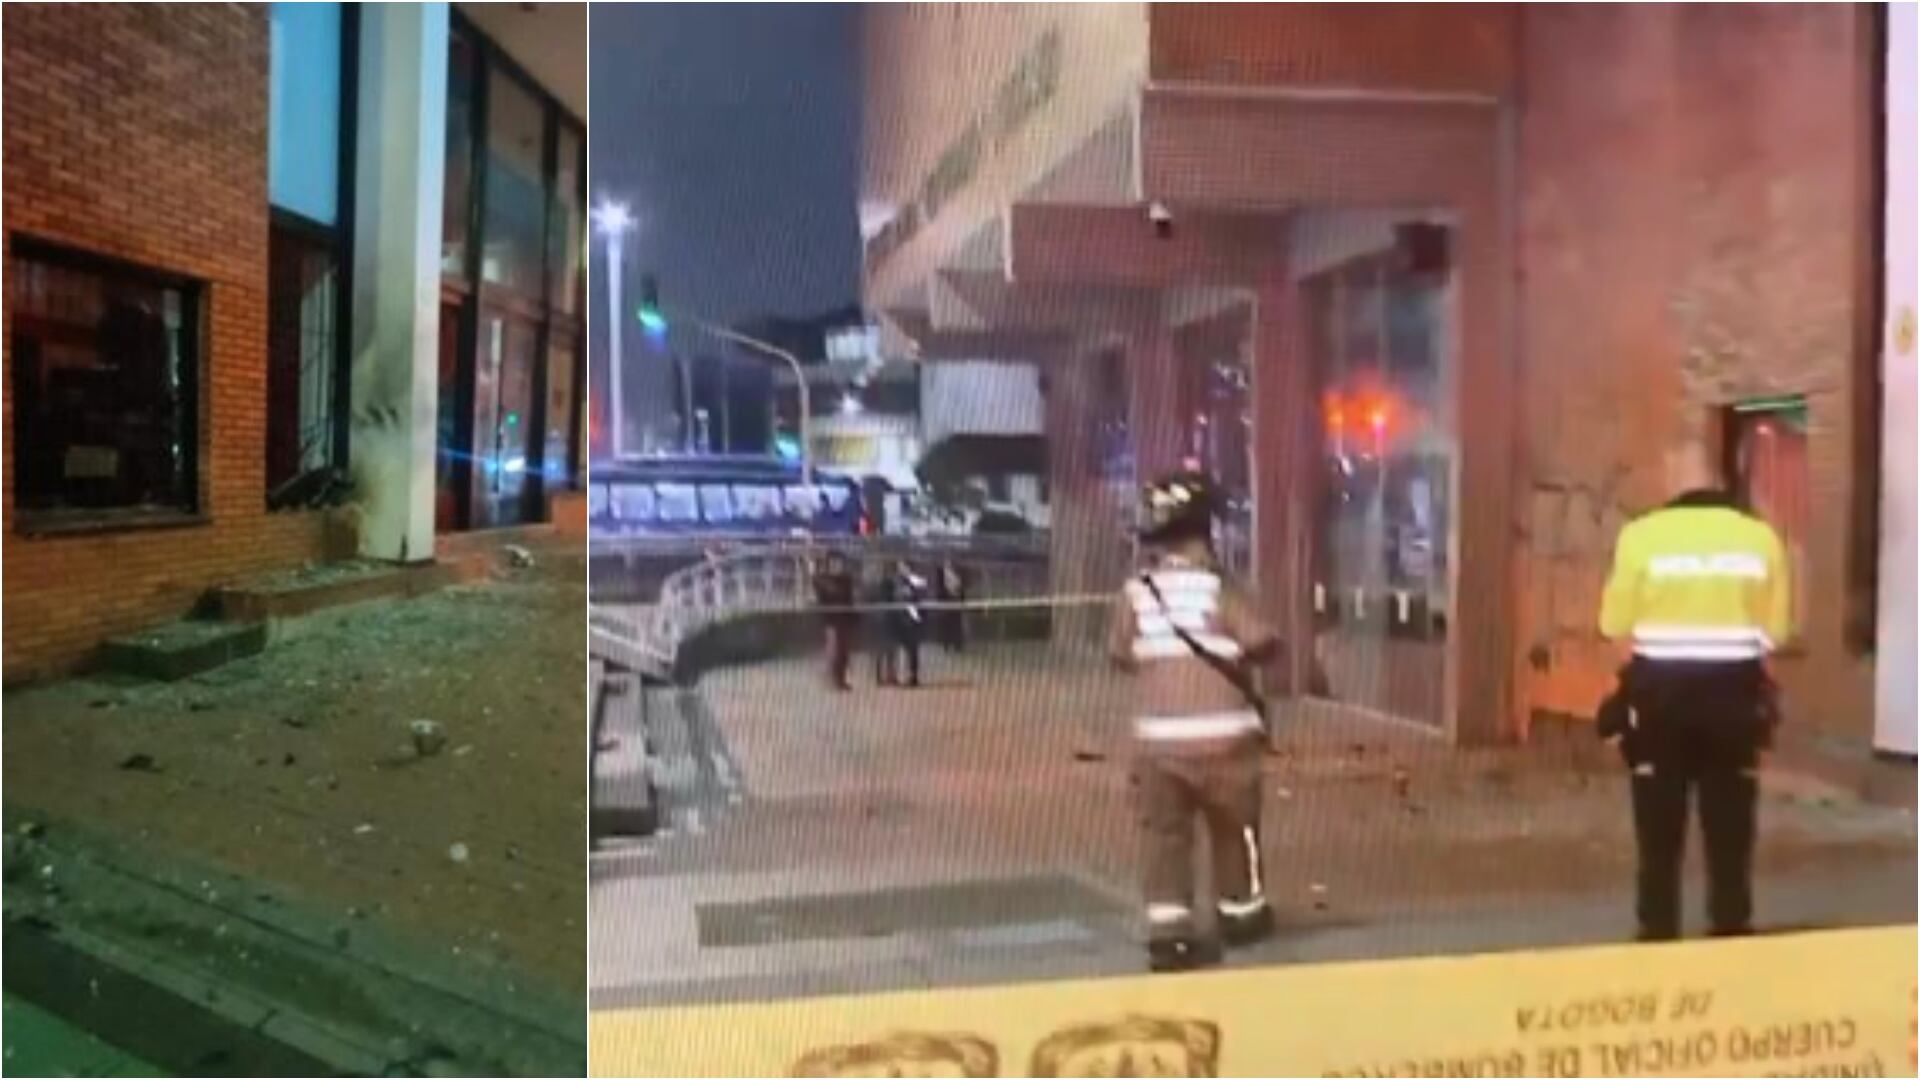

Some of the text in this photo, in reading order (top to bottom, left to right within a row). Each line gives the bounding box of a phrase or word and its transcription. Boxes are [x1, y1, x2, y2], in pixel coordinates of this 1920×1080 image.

[1537, 1045, 1580, 1078] DE
[1592, 1031, 1717, 1077] OFICIAL
[1729, 1018, 1856, 1062] CUERPO
